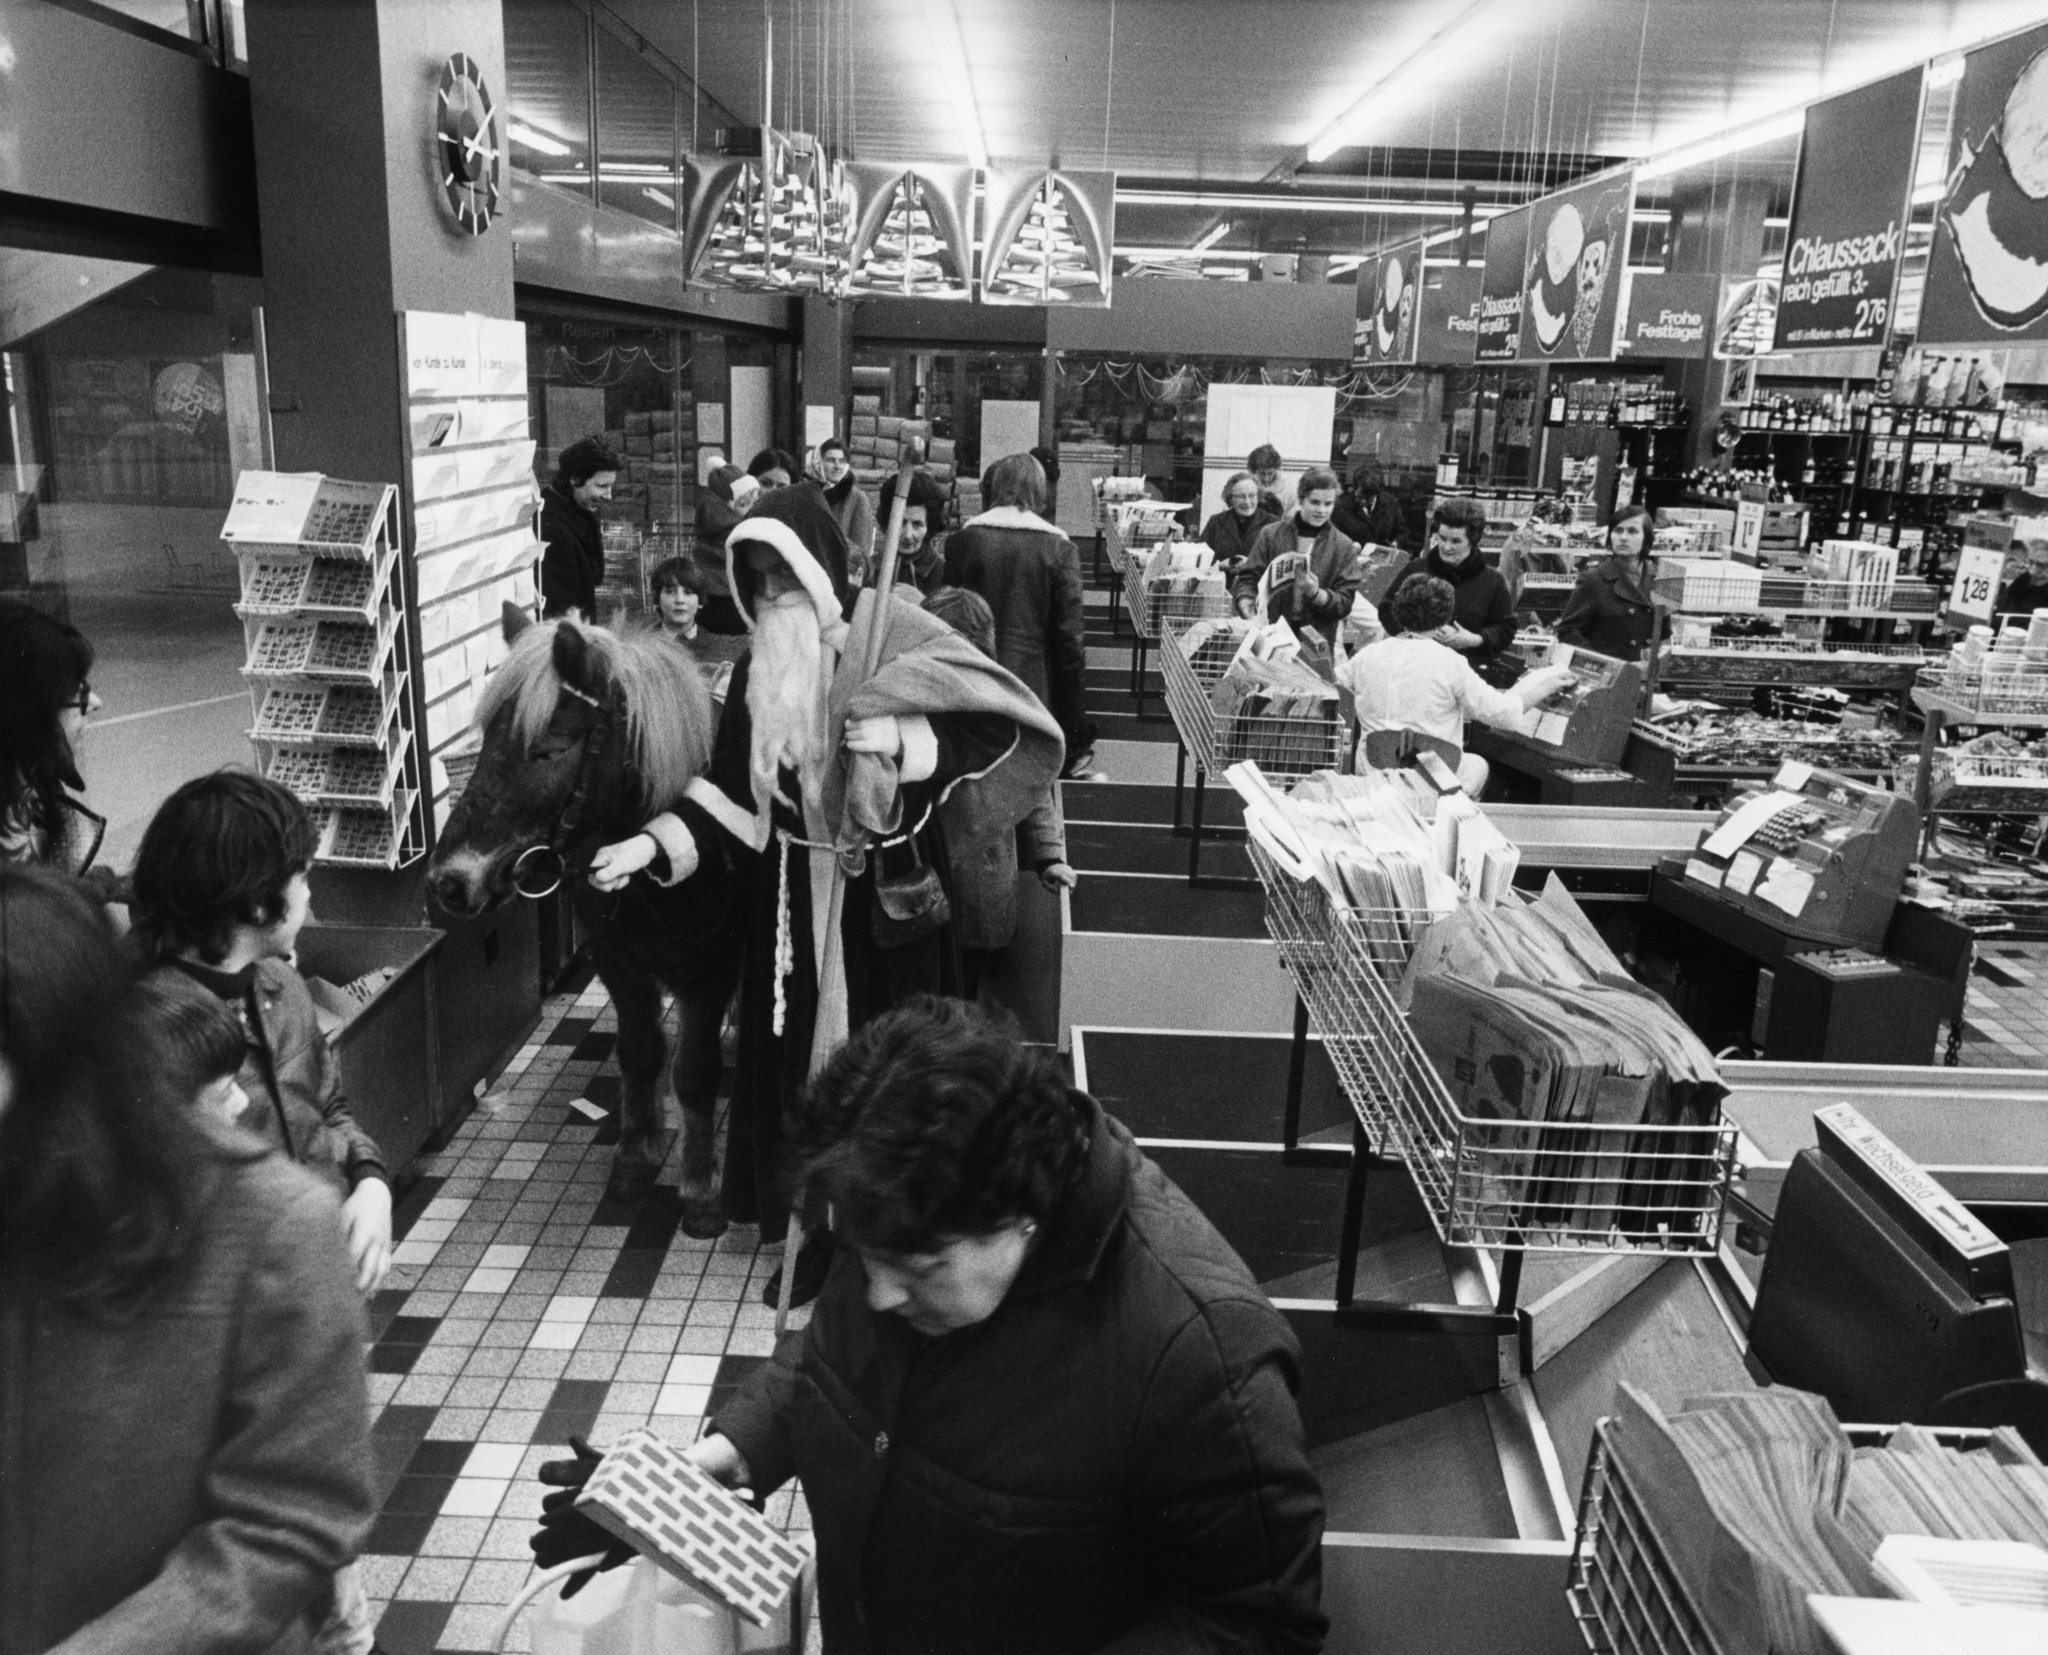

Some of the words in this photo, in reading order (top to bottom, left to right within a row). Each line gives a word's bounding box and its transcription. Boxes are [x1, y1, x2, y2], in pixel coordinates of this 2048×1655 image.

[1789, 221, 1899, 276] Chlaussack
[1782, 277, 1811, 303] reich
[1659, 309, 1701, 325] Frohe
[1852, 298, 1886, 339] 2.76
[1961, 576, 1989, 604] 1.28
[1841, 1113, 1860, 1133] Ihr
[1858, 1132, 1933, 1200] Wechselgeld
